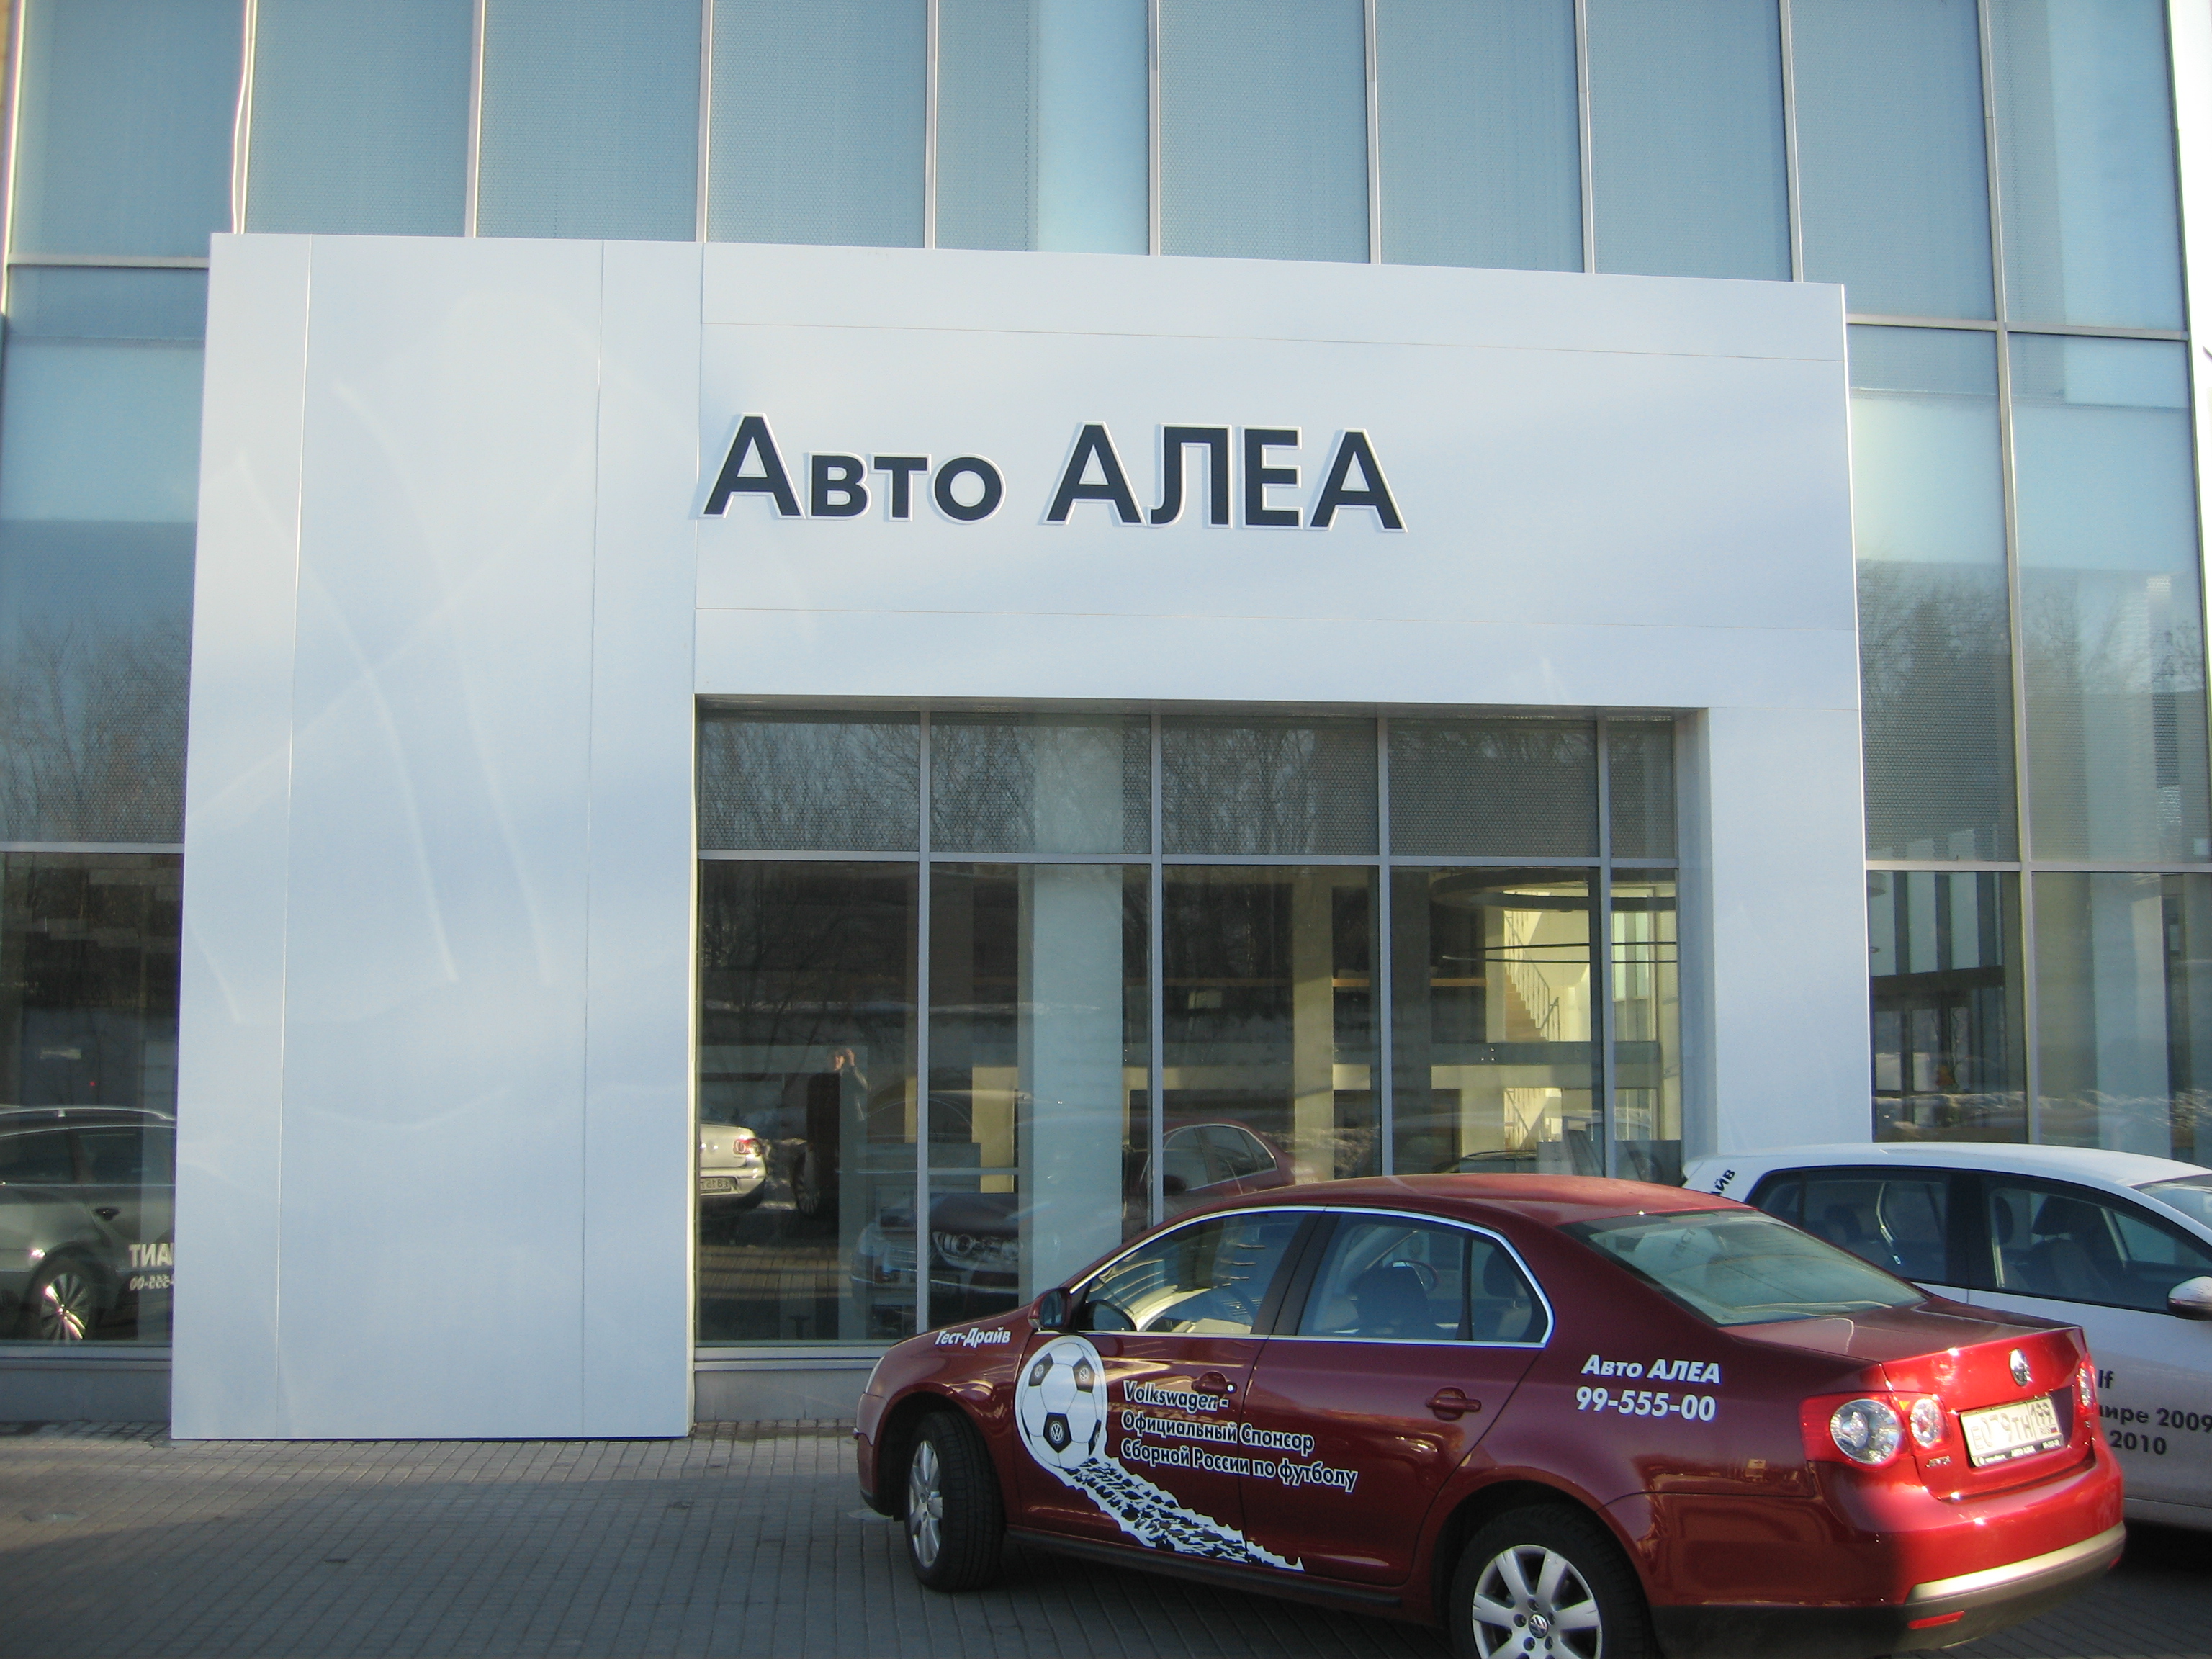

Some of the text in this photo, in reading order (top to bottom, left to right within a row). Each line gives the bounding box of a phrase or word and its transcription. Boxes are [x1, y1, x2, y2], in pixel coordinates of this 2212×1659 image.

[701, 413, 1408, 532] Авто АЛЕА
[935, 1326, 1011, 1348] Тест-Драйв
[1581, 1354, 1721, 1384] Авто АЛЕА
[2098, 1369, 2113, 1389] lf
[1575, 1385, 1717, 1421] 99-555-00
[1121, 1409, 1315, 1457] Официальный Спонсор
[2156, 1408, 2212, 1433] 2009
[2109, 1430, 2167, 1455] 2010
[1121, 1437, 1358, 1493] Сборной России по футболу
